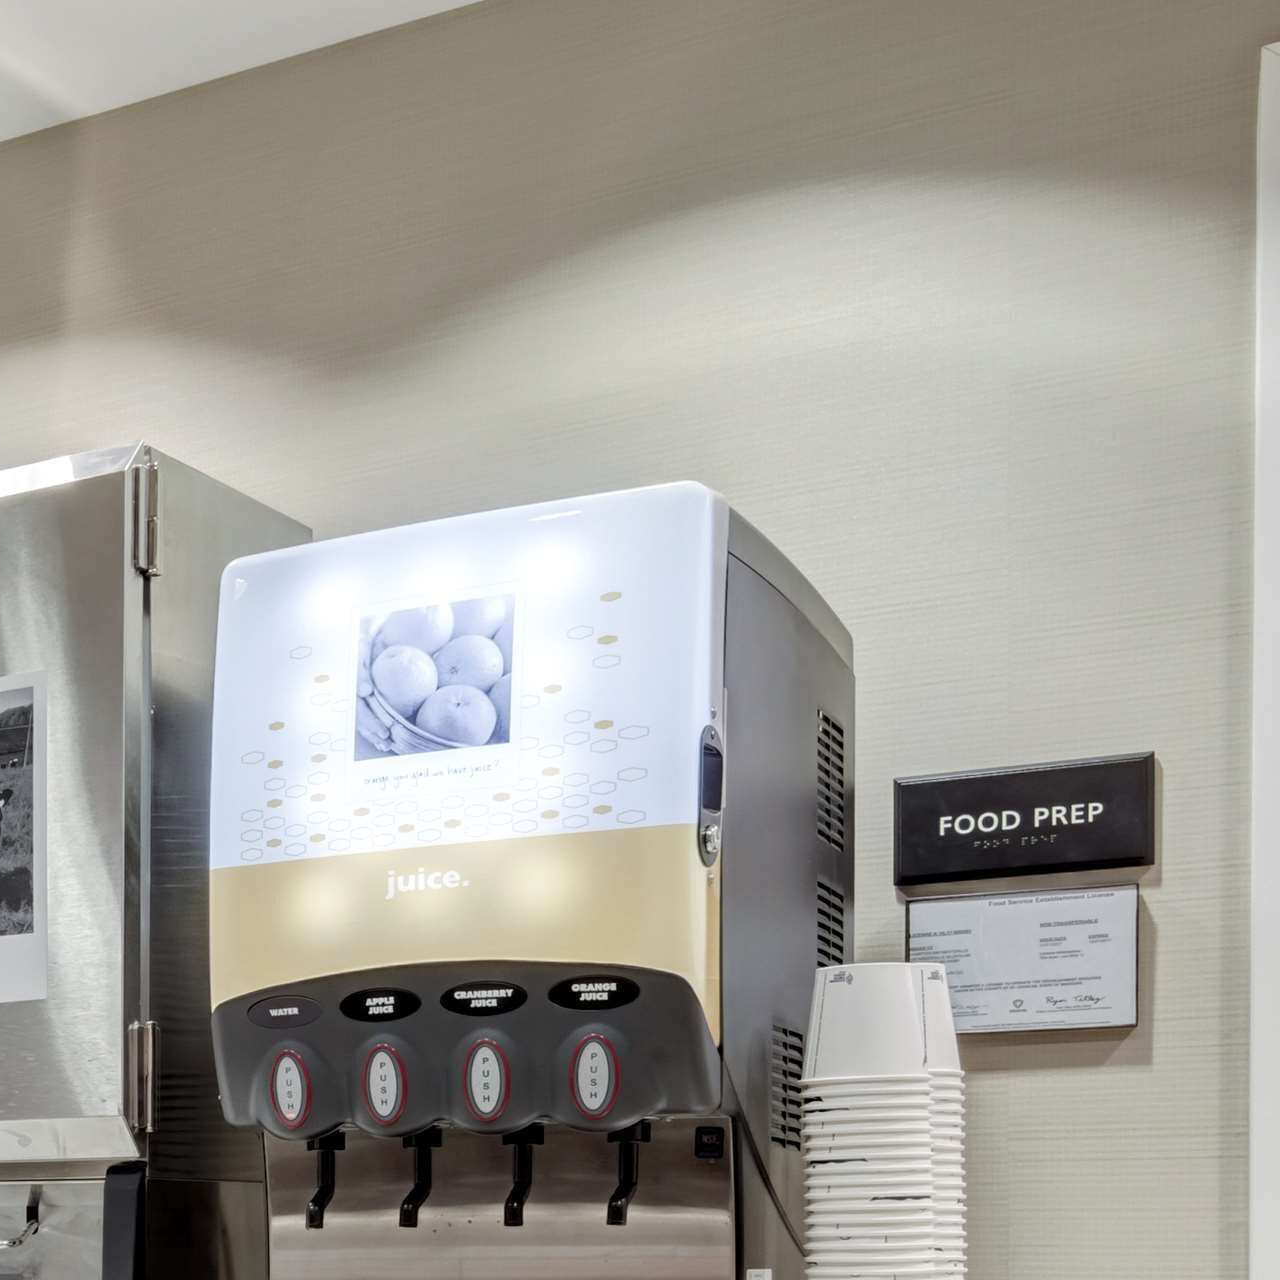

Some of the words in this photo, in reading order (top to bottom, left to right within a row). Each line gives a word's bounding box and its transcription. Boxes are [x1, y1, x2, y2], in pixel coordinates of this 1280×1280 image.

[939, 810, 1021, 836] FOOD
[1034, 802, 1104, 828] PREP
[385, 867, 471, 900] juice.
[571, 982, 617, 993] ORANGE
[454, 988, 514, 1000] CRANBERRY
[579, 992, 608, 1002] JUICE
[365, 996, 395, 1007] APPLE
[470, 998, 498, 1008] JUICE
[269, 1007, 299, 1017] WATER
[368, 1005, 394, 1015] JUICE
[482, 1057, 490, 1103] PUSH
[590, 1052, 598, 1099] PUSH
[285, 1067, 294, 1110] PUSH
[379, 1062, 388, 1106] PUSH
